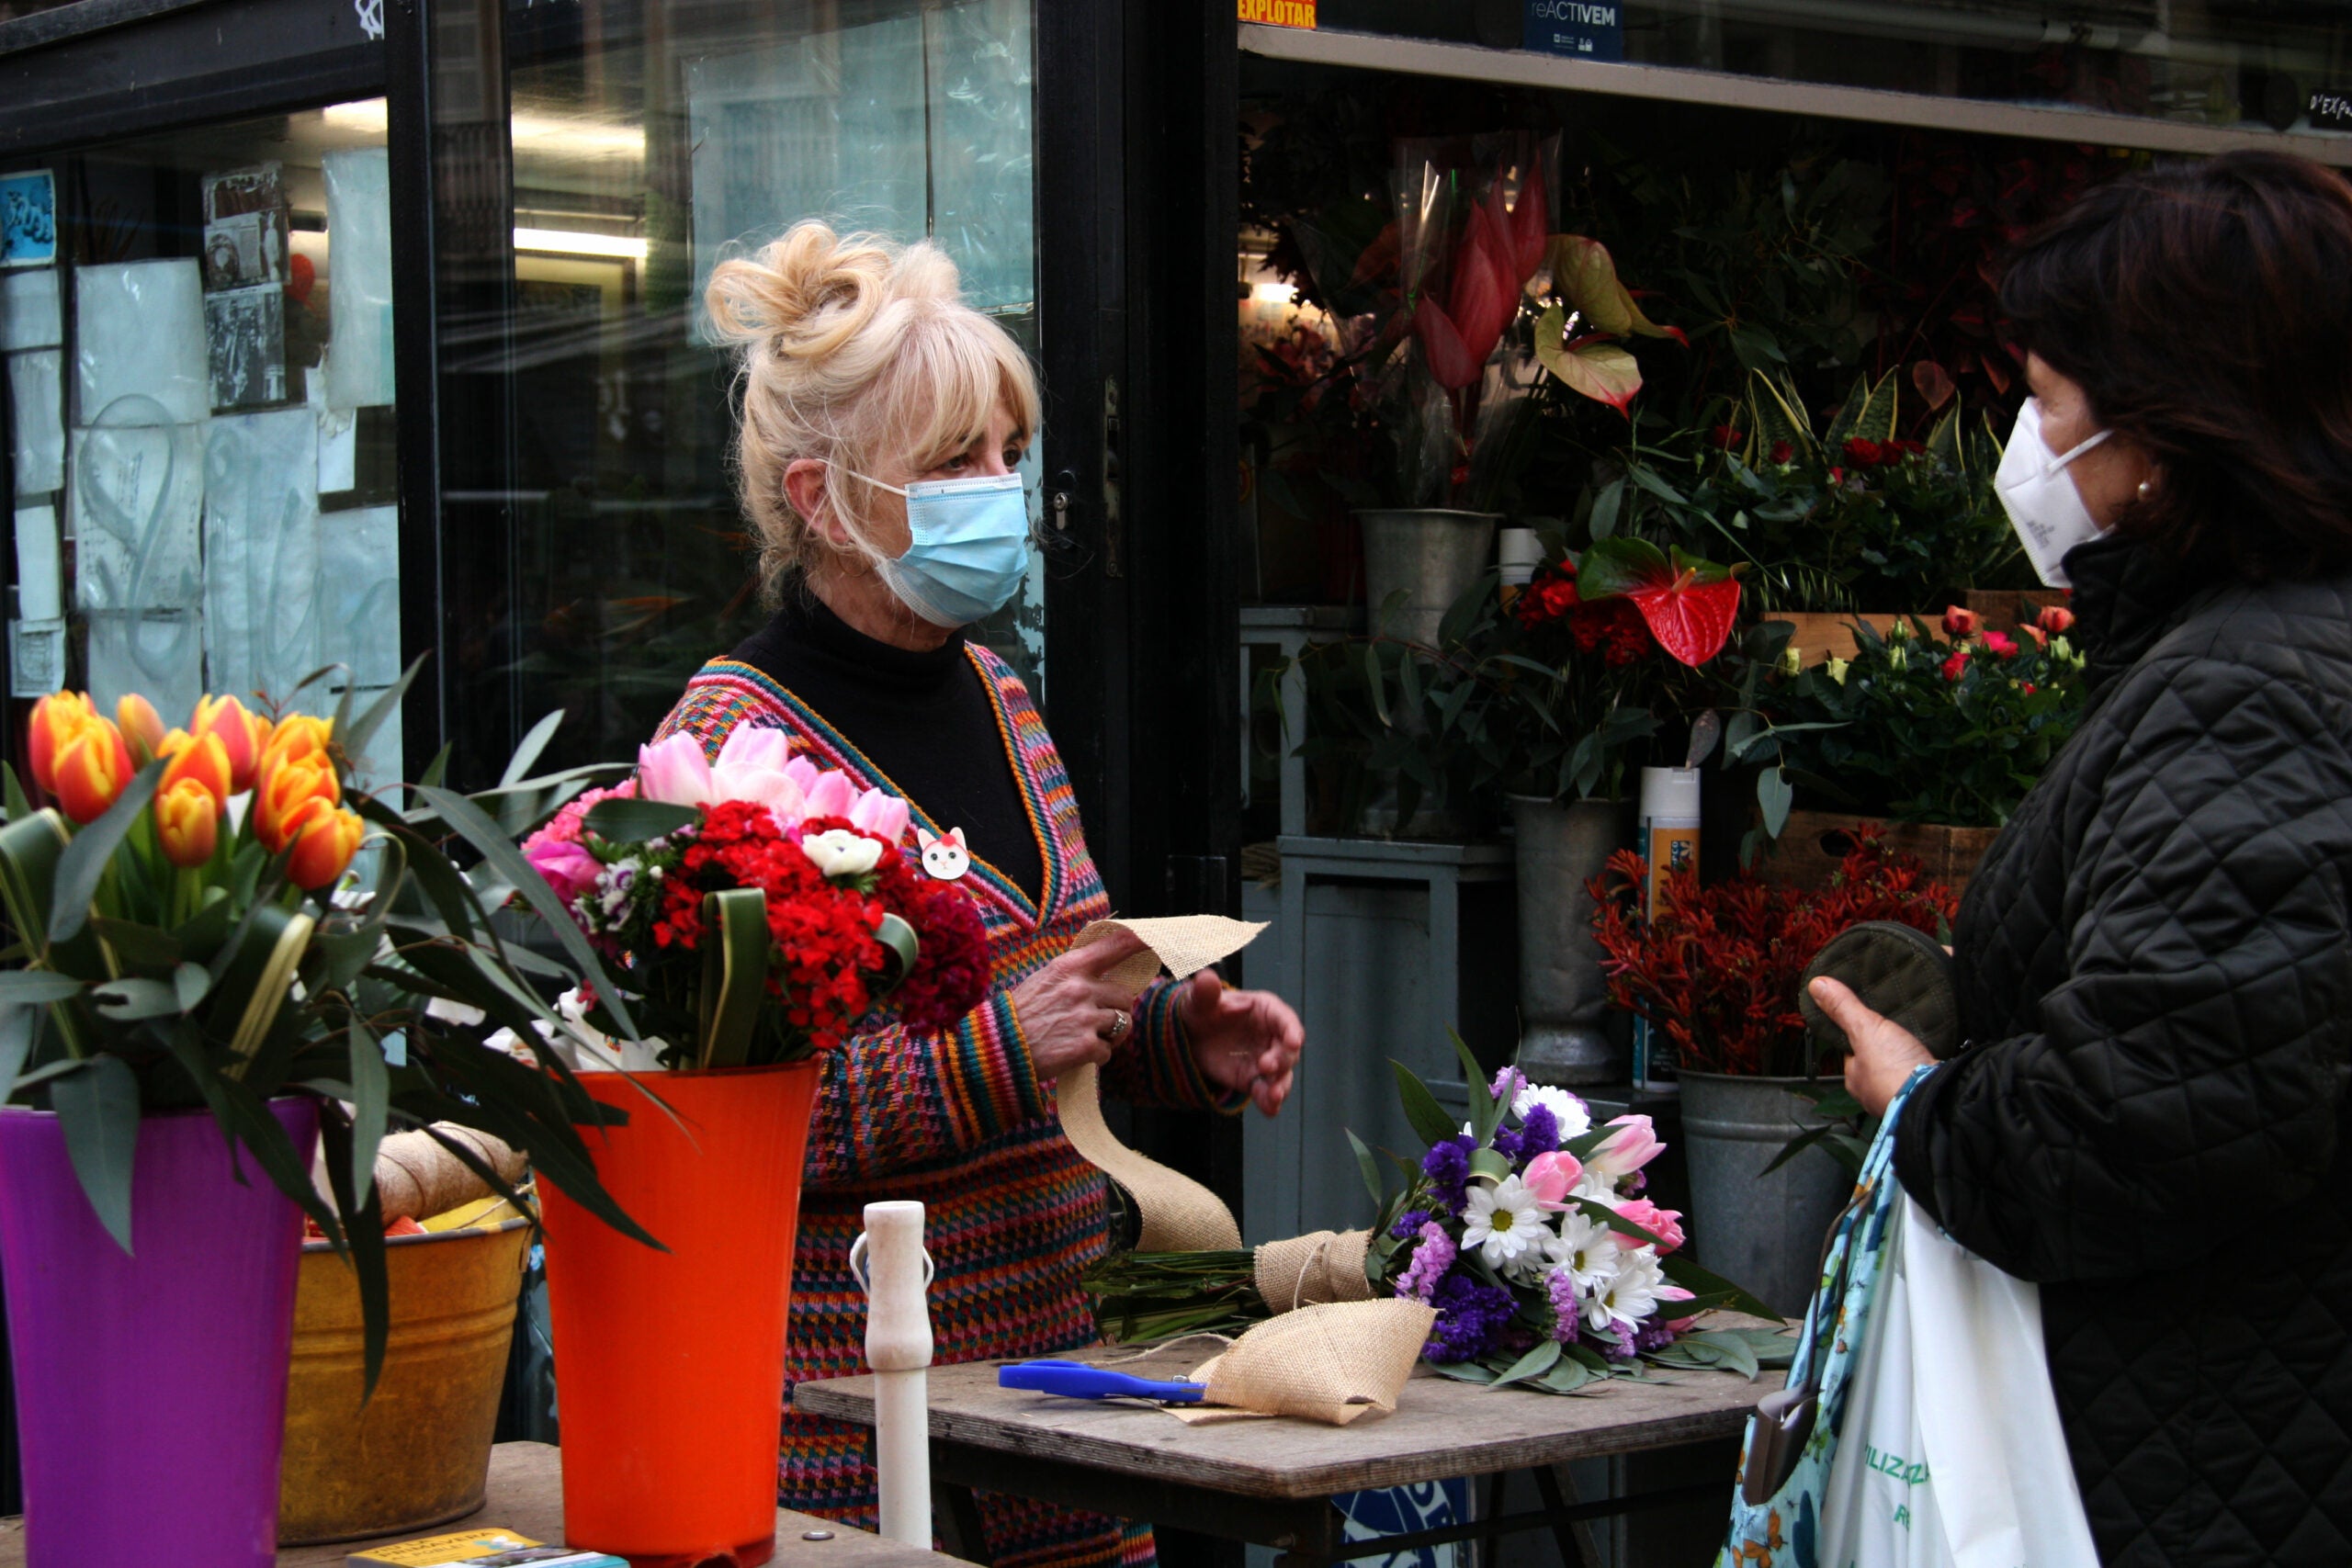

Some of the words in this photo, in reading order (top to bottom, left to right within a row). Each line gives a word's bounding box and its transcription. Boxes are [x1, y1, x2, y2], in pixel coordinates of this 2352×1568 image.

[1238, 0, 1317, 28] EXPLOTAR
[1532, 0, 1615, 26] reACTIVEM
[379, 1531, 494, 1557] PRIMAVERA
